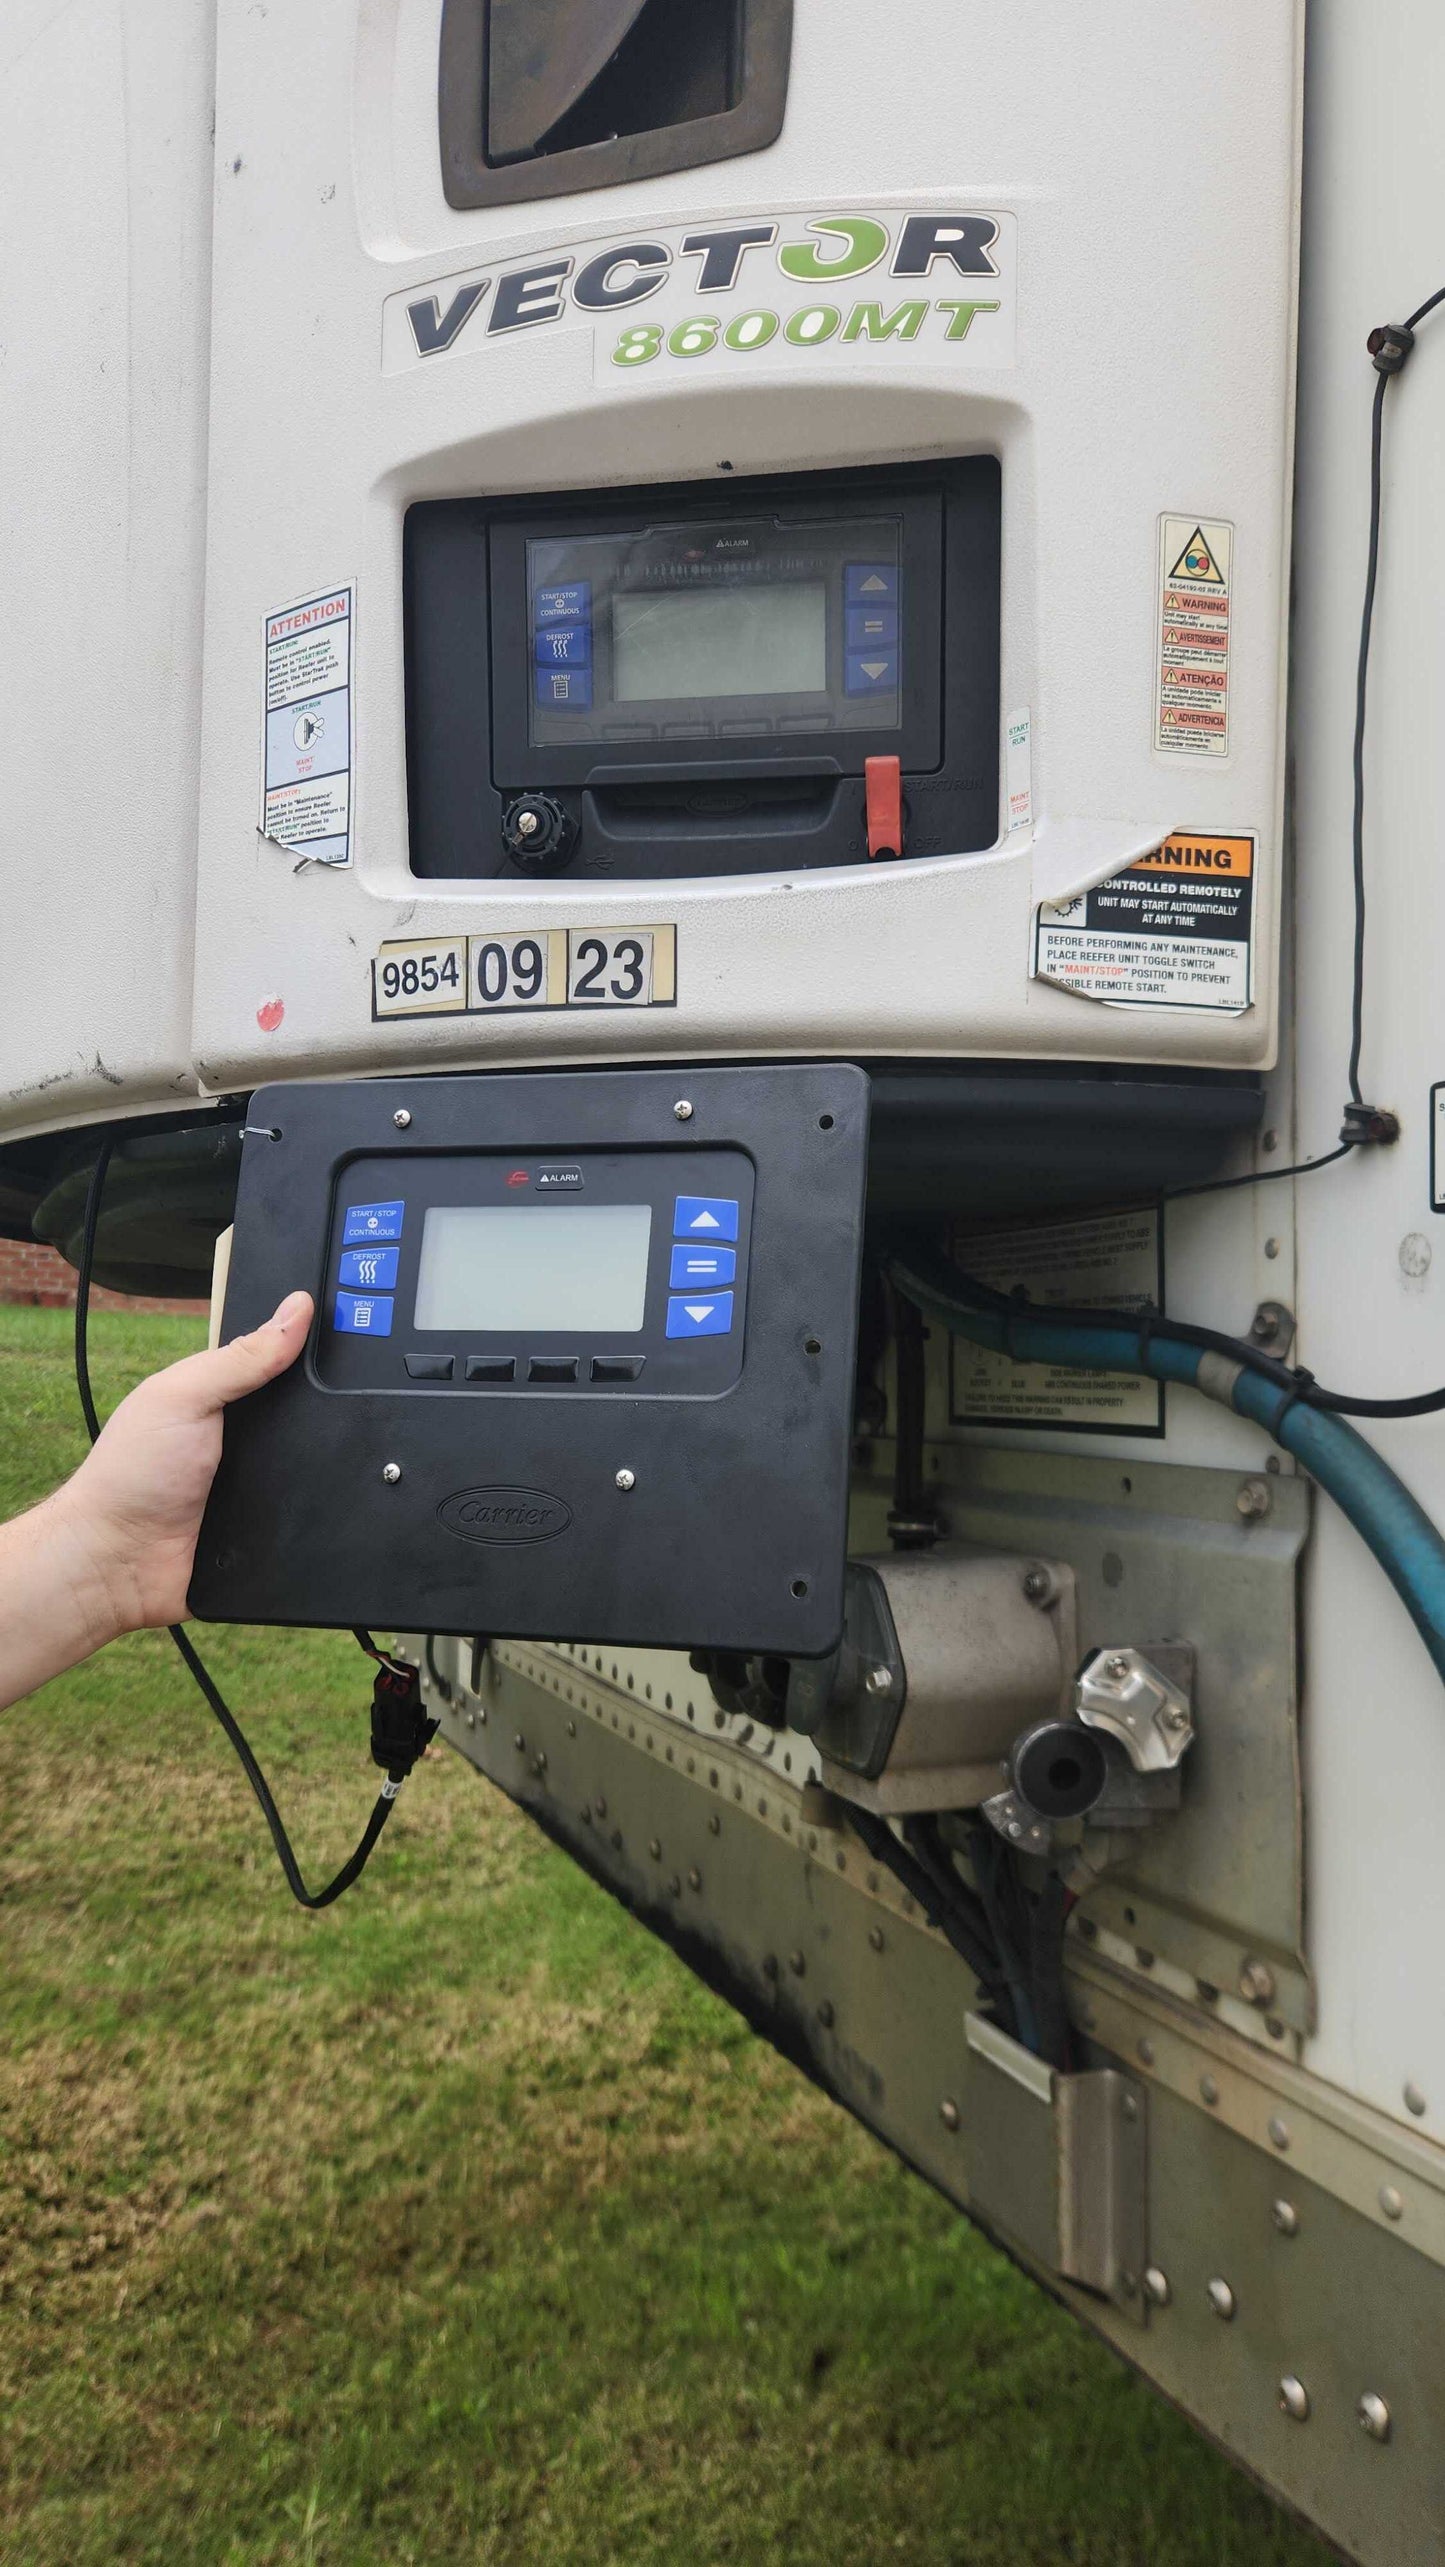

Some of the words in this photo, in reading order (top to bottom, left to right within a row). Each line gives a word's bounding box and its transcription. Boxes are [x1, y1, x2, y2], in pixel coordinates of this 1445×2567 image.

[406, 213, 1000, 357] VECTOR
[610, 299, 1000, 366] 8600MT
[724, 539, 749, 548] ALARM
[540, 607, 580, 617] CONTINUOUS
[1182, 598, 1226, 612] WARNING
[269, 598, 345, 638] ATTENTION
[546, 632, 574, 641] DEFROST
[1180, 632, 1225, 646] AVERTISSEMENT
[1180, 673, 1224, 687] ATENÇÃO
[1178, 713, 1225, 727] ADVERTENCIA
[1008, 722, 1030, 736] START
[1011, 735, 1026, 747] RUN
[904, 778, 984, 793] START/RUN
[1010, 791, 1030, 803] MAINT
[1011, 803, 1028, 815] STOP
[913, 836, 943, 849] OFF
[1138, 846, 1232, 869] RNING
[1179, 884, 1242, 899] REMOTELY
[1097, 896, 1119, 907] UNIT
[1120, 898, 1140, 909] MAY
[1141, 899, 1169, 911] START
[1170, 902, 1239, 916] AUTOMATICALLY
[1142, 913, 1153, 924] AT
[1154, 914, 1173, 925] ANY
[1174, 915, 1196, 927] TIME
[1047, 935, 1084, 947] BEFORE
[1086, 938, 1148, 951] PERFORMING
[1150, 942, 1169, 953] ANY
[1172, 944, 1239, 959] MAINTENANCE,
[1047, 949, 1077, 960] PLACE
[1080, 951, 1115, 963] REEFER
[1118, 954, 1140, 964] UNIT
[1143, 955, 1178, 967] TOGGLE
[1180, 958, 1215, 970] SWITCH
[382, 951, 460, 998] 9854
[477, 939, 543, 1002] 09
[573, 938, 644, 1000] 23
[1046, 963, 1057, 973] IN
[1131, 968, 1174, 981] POSITION
[1177, 971, 1188, 981] TO
[1191, 972, 1231, 985] PREVENT
[1095, 980, 1134, 991] REMOTE
[1136, 982, 1167, 994] START.
[550, 1174, 578, 1182] ALARM
[348, 1228, 395, 1236] CONTINUOUS
[353, 1300, 375, 1308] MENU
[458, 1500, 556, 1525] Carrier
